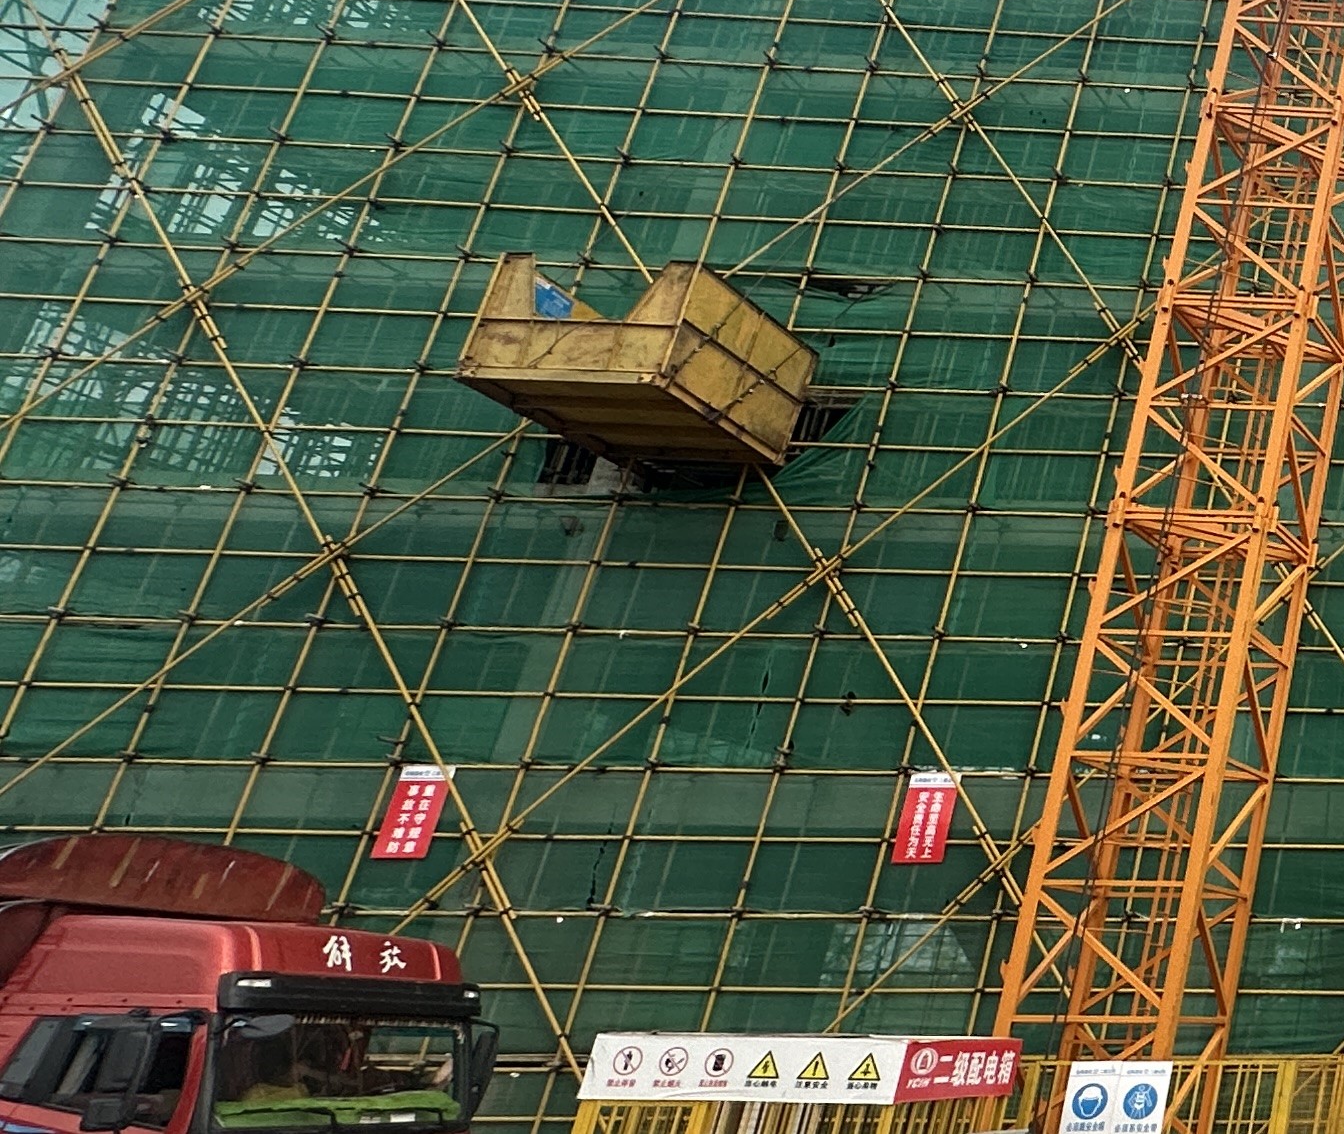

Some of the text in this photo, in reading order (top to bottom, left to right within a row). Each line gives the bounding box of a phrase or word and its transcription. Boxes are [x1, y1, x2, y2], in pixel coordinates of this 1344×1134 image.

[322, 935, 408, 974] 解放
[795, 1080, 829, 1089] 注意安全
[933, 1049, 1016, 1086] 二级配电箱
